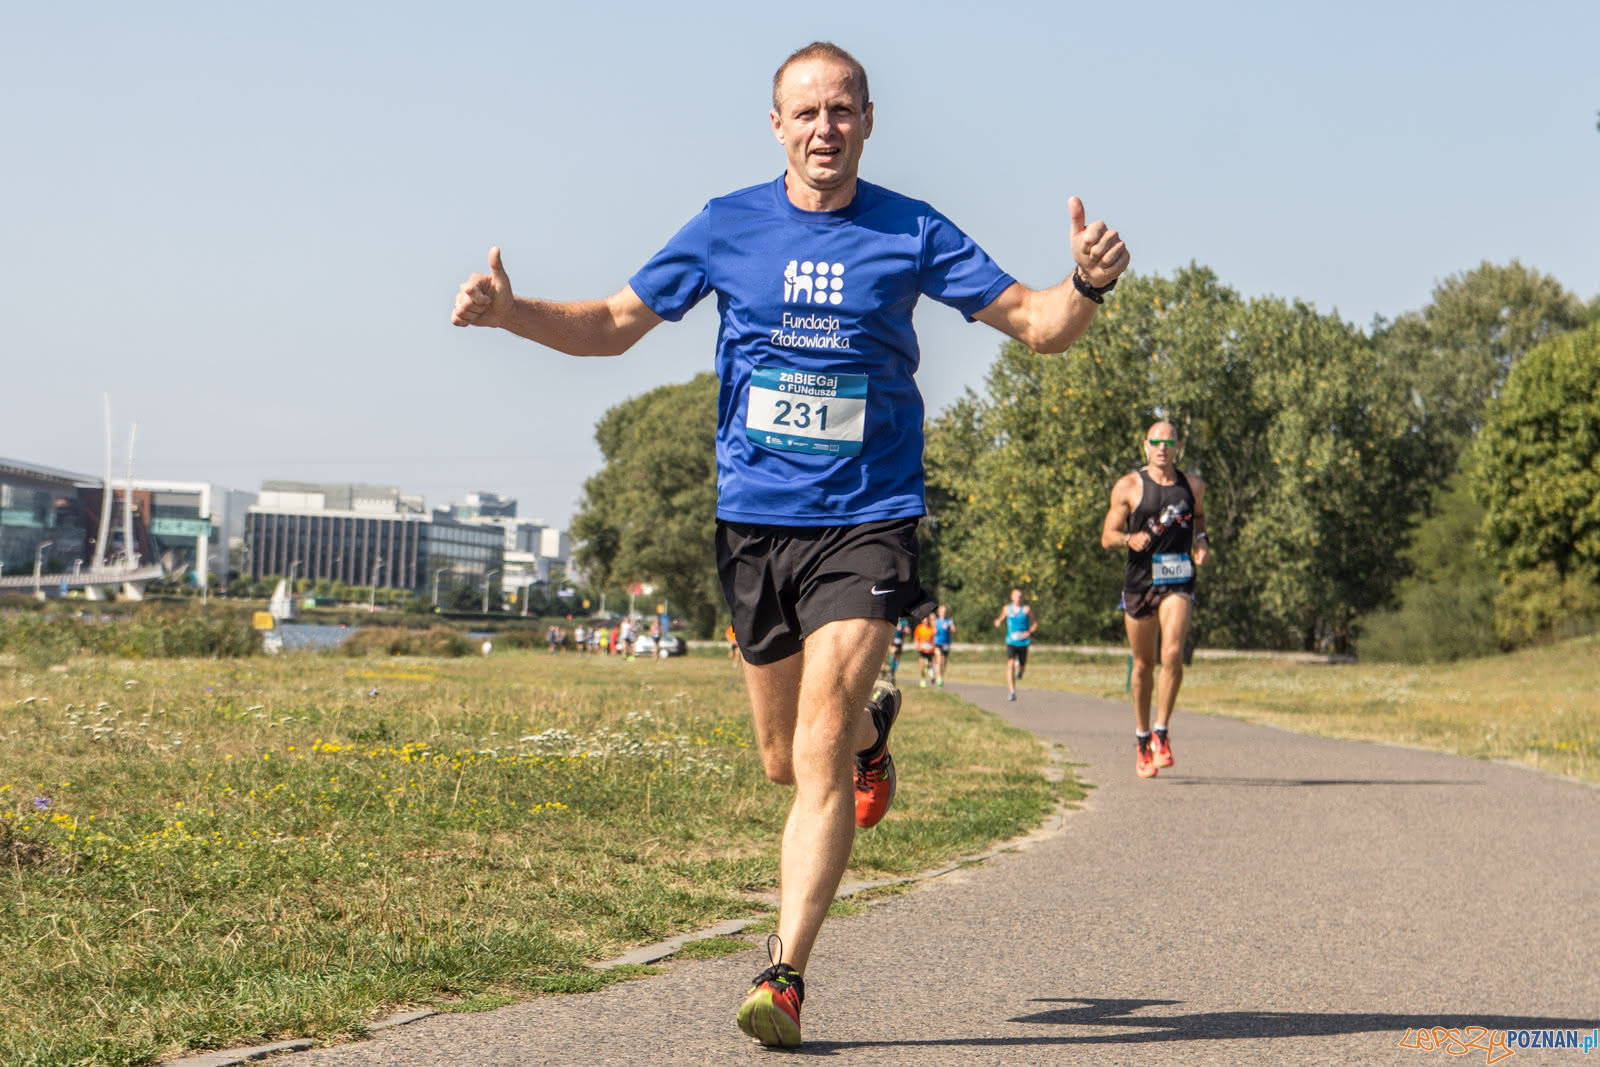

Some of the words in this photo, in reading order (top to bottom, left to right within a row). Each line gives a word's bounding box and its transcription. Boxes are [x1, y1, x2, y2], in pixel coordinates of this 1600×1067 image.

[783, 312, 840, 335] Fundacja
[770, 329, 850, 349] Złotowianka
[779, 372, 838, 389] zaBIEGaj
[787, 384, 837, 397] FUNdusze
[773, 399, 829, 431] 231
